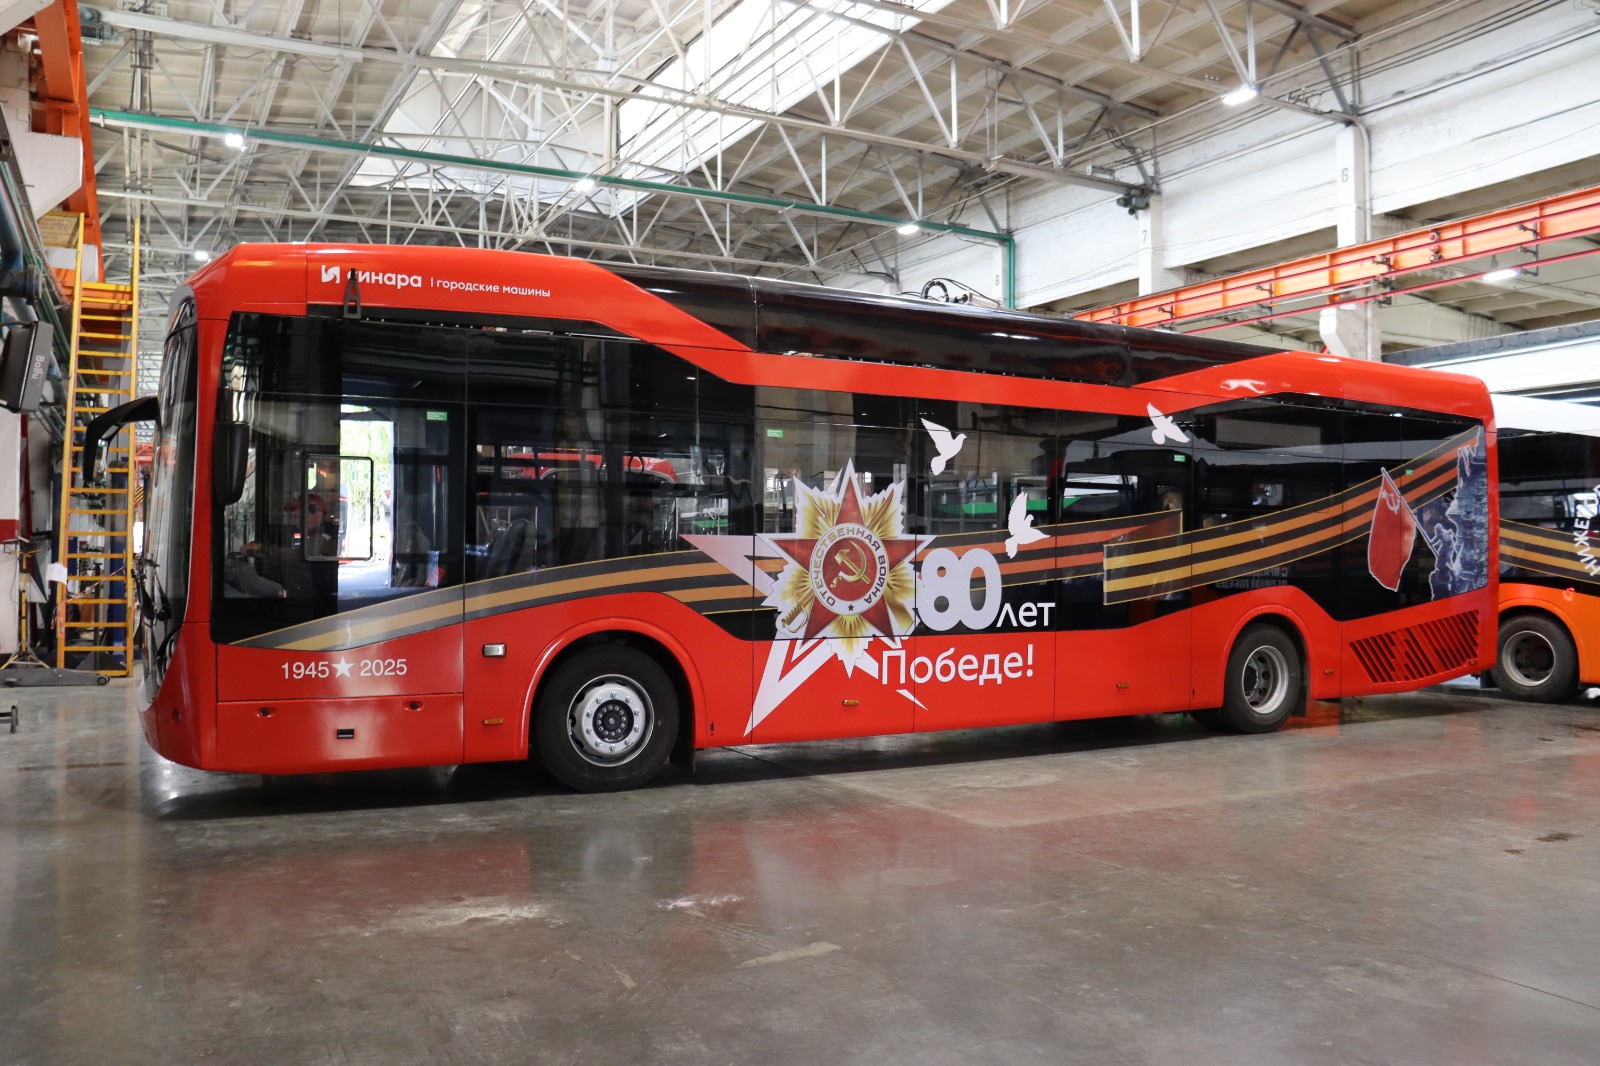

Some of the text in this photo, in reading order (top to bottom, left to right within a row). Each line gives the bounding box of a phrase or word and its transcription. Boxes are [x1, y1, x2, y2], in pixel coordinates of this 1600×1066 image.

[1341, 167, 1349, 183] 6
[1142, 229, 1148, 243] 7
[436, 279, 500, 293] городские
[502, 286, 551, 298] машины
[32, 354, 45, 380] Ballu
[813, 526, 881, 607] ОТЕЧЕСТВЕННАЯ
[917, 547, 1056, 632] 80 лет
[281, 658, 408, 679] 1945 2025
[882, 643, 1034, 686] Победе!
